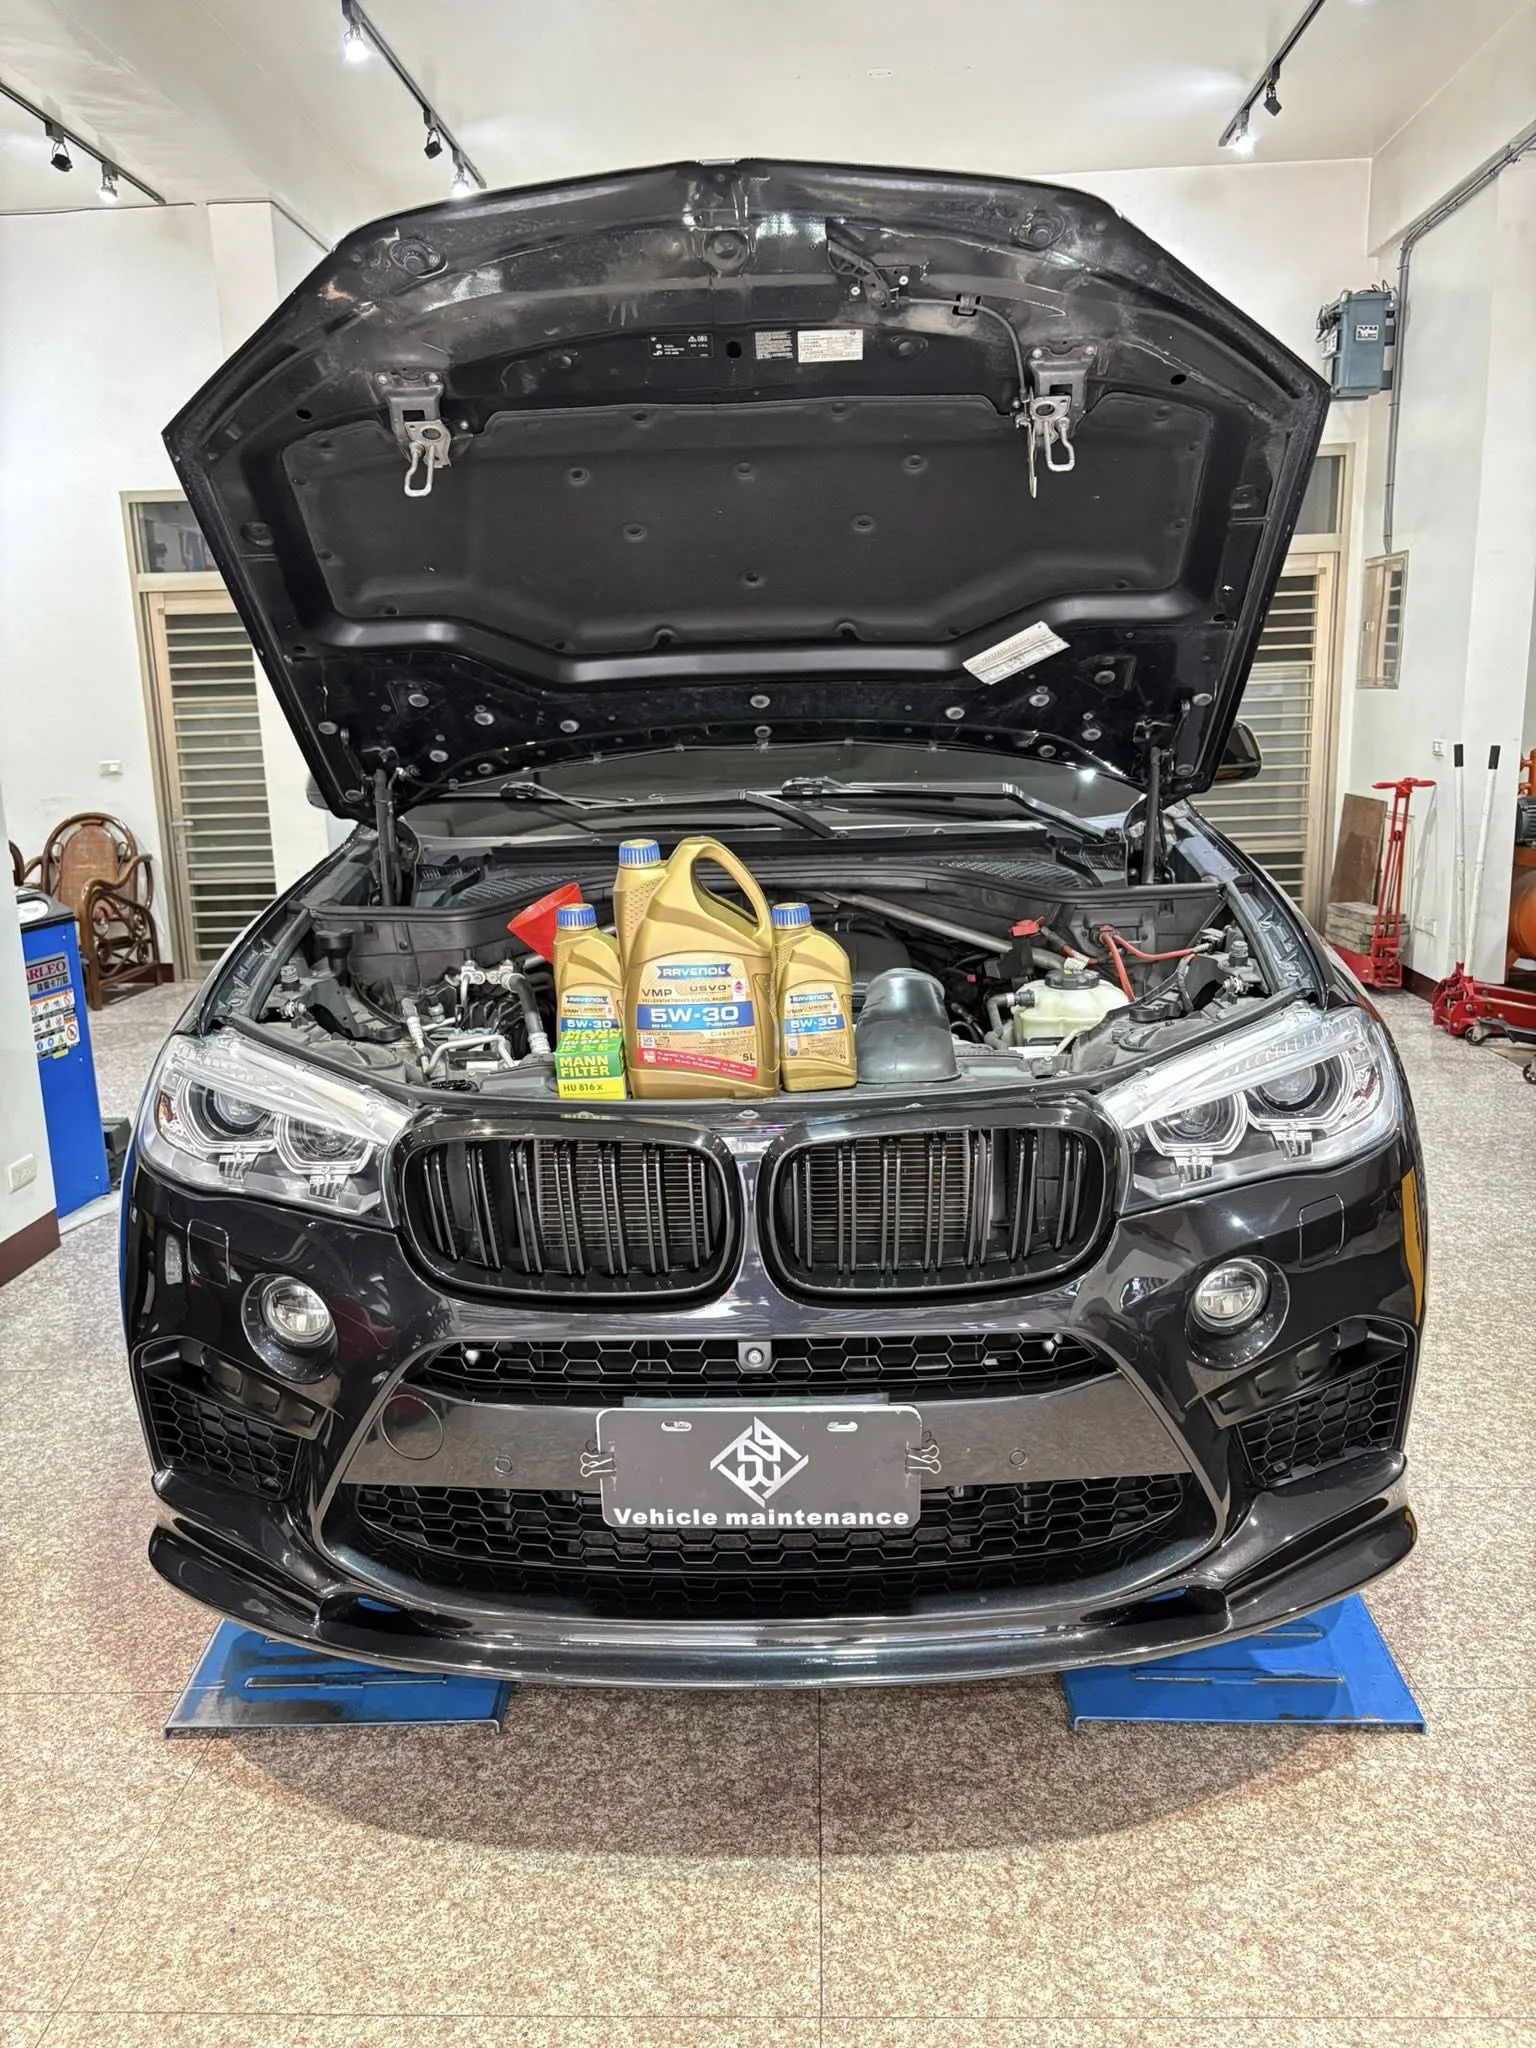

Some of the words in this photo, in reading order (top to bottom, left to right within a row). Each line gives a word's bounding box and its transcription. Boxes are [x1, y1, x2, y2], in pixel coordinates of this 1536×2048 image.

[663, 966, 726, 977] RAVENOL
[641, 988, 673, 998] VMP
[650, 1006, 739, 1023] 5W-30
[566, 1019, 612, 1029] 5W-30
[790, 1016, 838, 1029] 5W-30
[560, 1055, 609, 1067] MANN
[742, 1053, 756, 1062] 5L
[560, 1066, 610, 1078] FILTER
[563, 1084, 577, 1092] HU
[613, 1508, 718, 1526] Vehicle
[725, 1508, 910, 1526] maintenance
